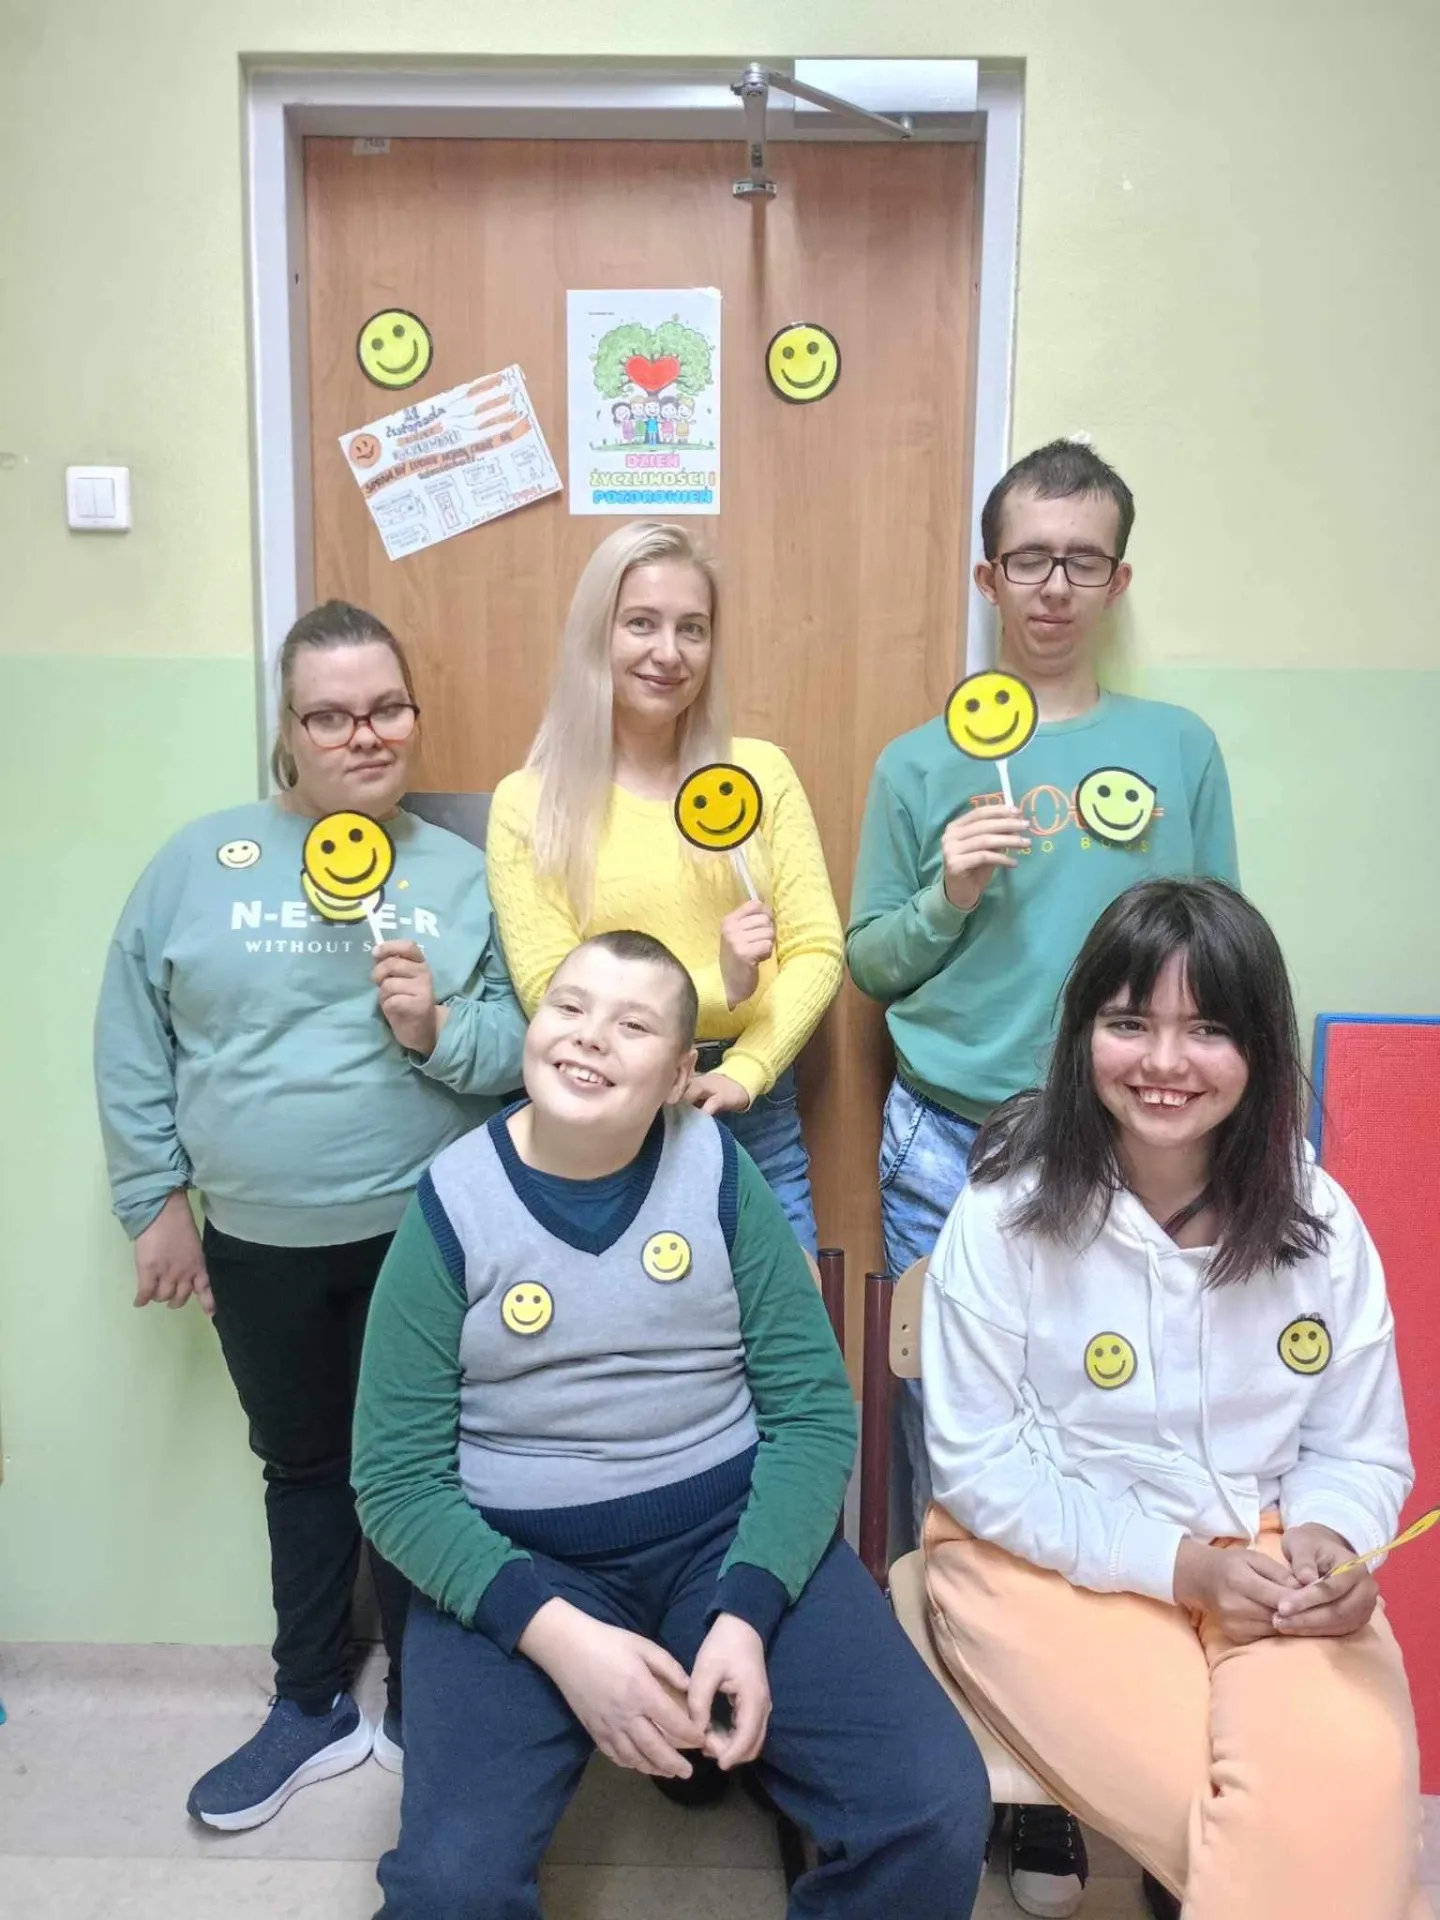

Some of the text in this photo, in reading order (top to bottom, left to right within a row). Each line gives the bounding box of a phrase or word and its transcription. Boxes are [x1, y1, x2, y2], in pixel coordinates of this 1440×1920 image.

[625, 450, 680, 468] DZIEŃ
[592, 485, 713, 504] POZDROWIEŃ
[231, 900, 441, 938] N-E--E-R
[244, 940, 353, 953] WITHOUT
